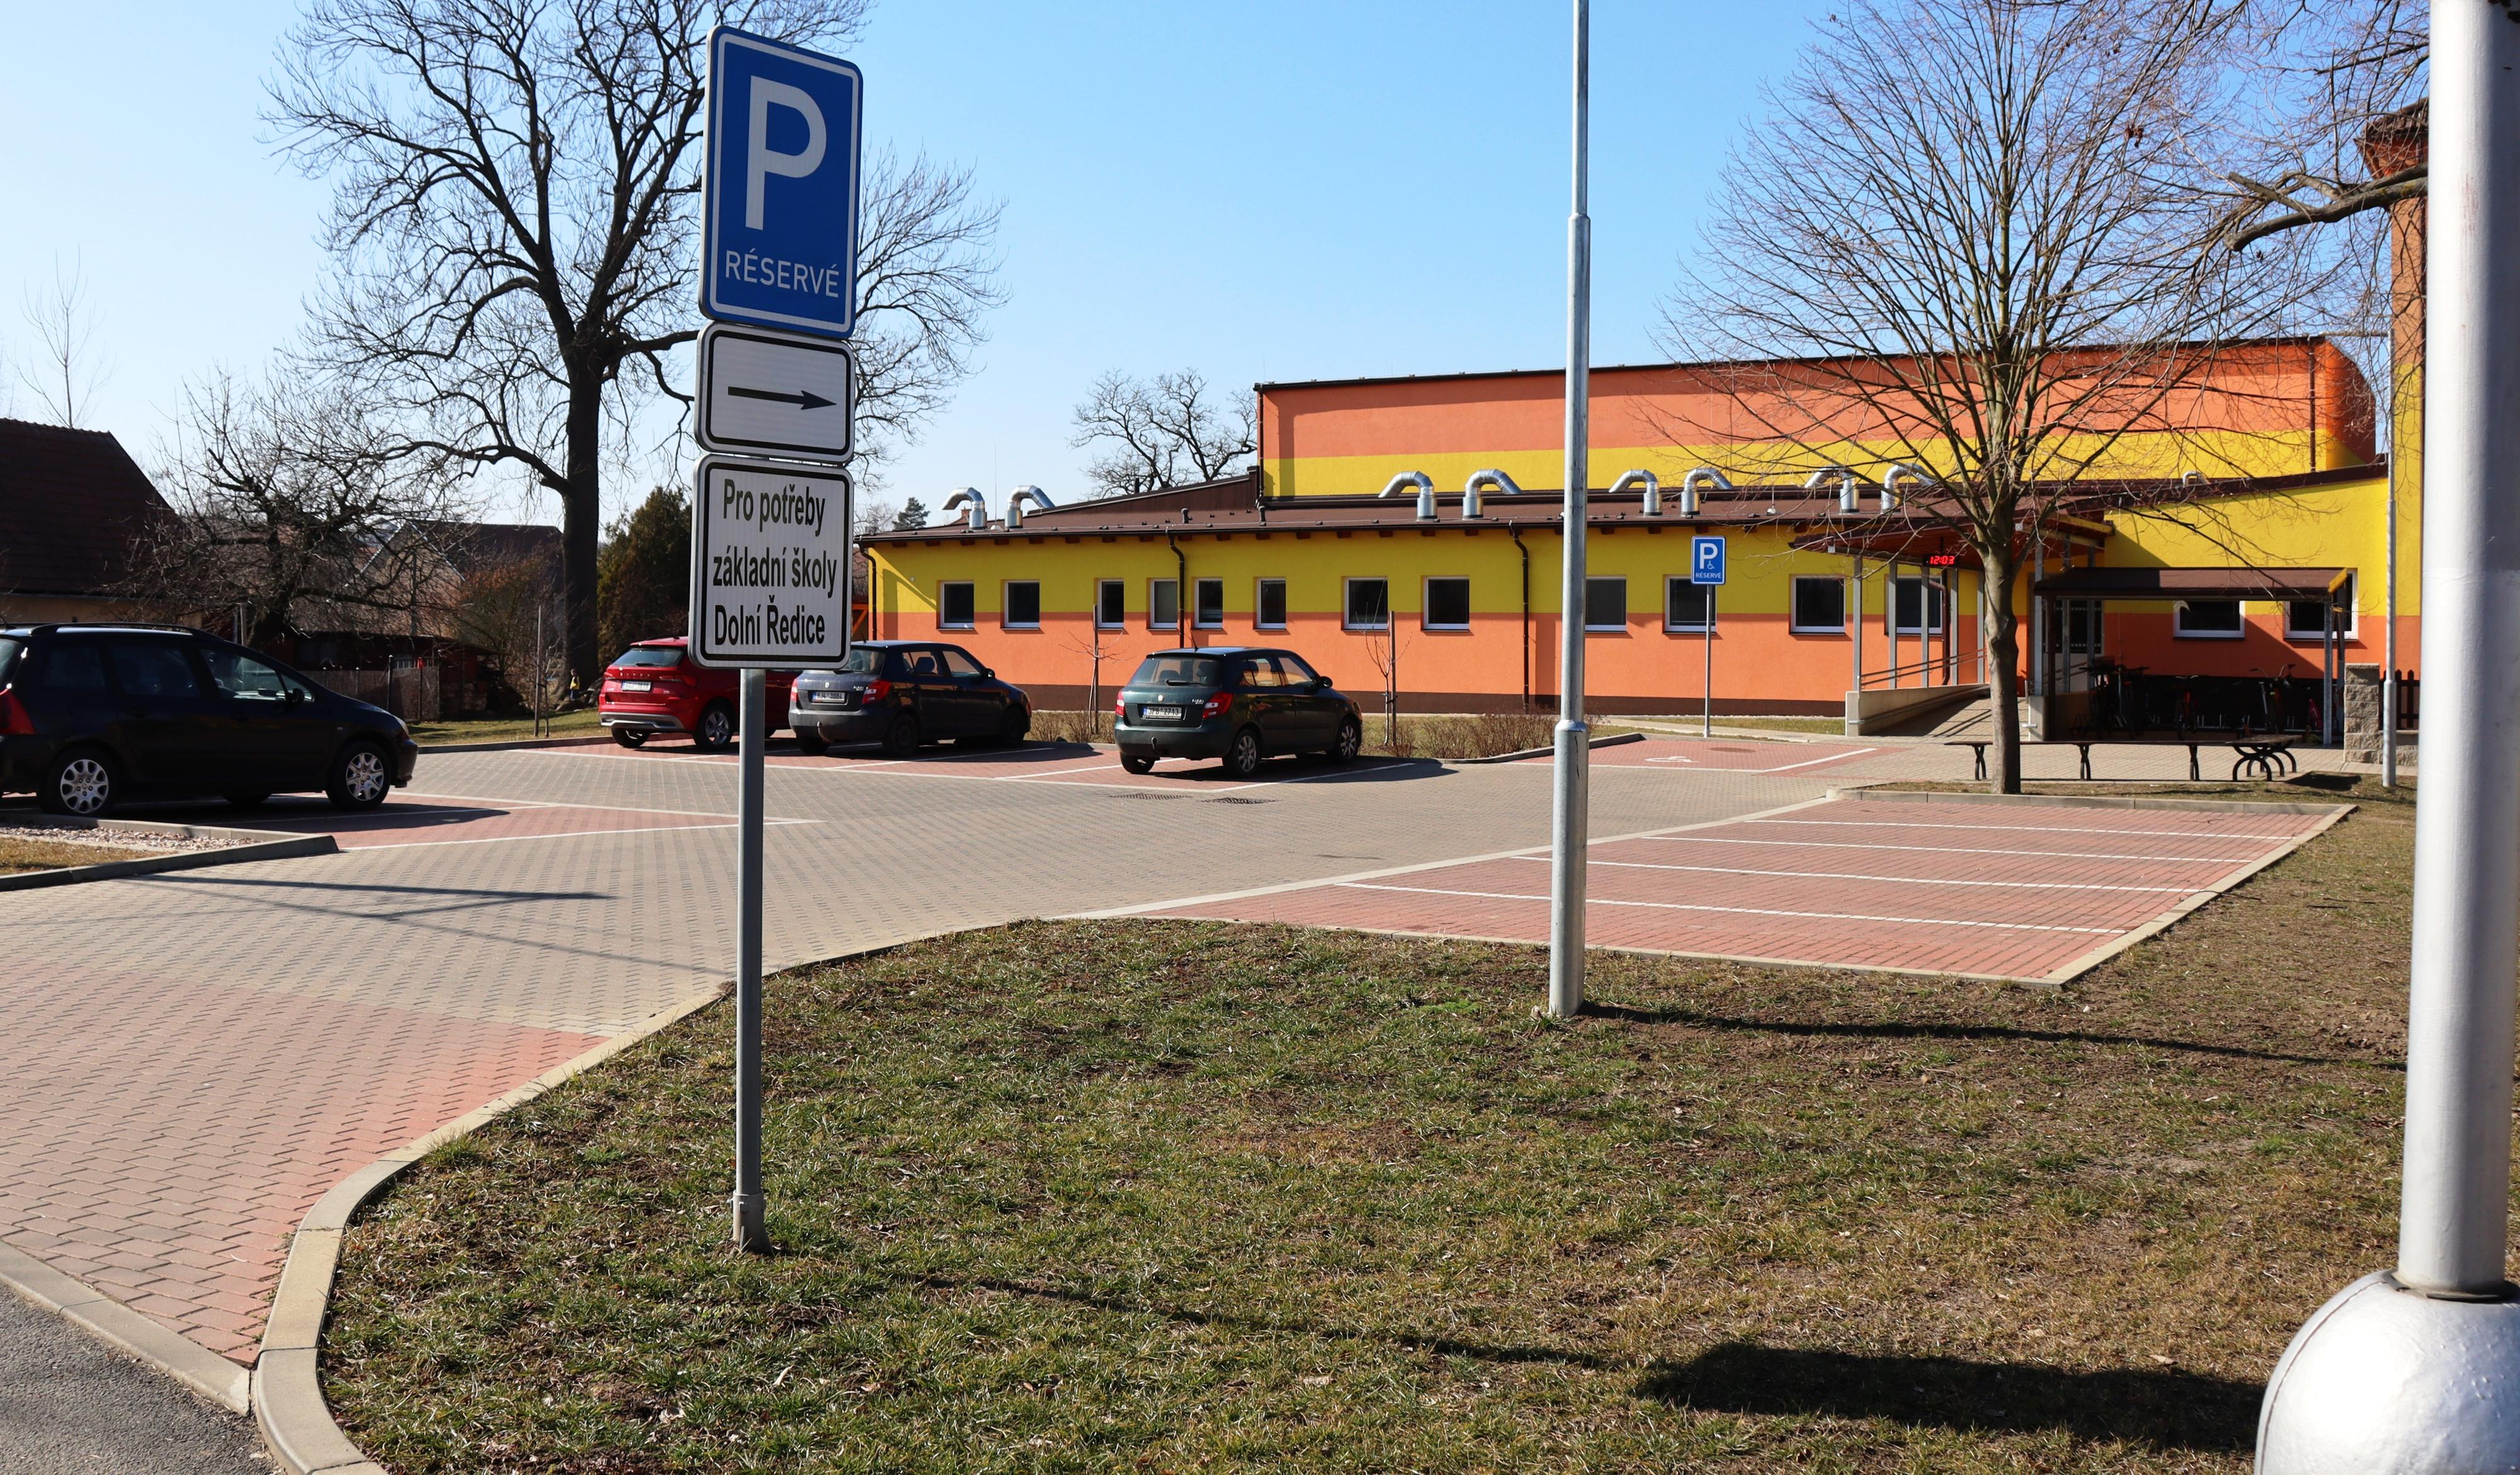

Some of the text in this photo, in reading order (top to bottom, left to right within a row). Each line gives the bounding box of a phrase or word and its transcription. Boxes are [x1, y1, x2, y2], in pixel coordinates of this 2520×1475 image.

[745, 75, 827, 231] P
[725, 248, 839, 298] RÉSERVÉ
[723, 478, 825, 537] Pro potřeby
[713, 545, 837, 599] základní školy
[1699, 542, 1718, 570] P
[1930, 555, 1955, 565] 12:03
[714, 595, 825, 645] Dolní Ředice
